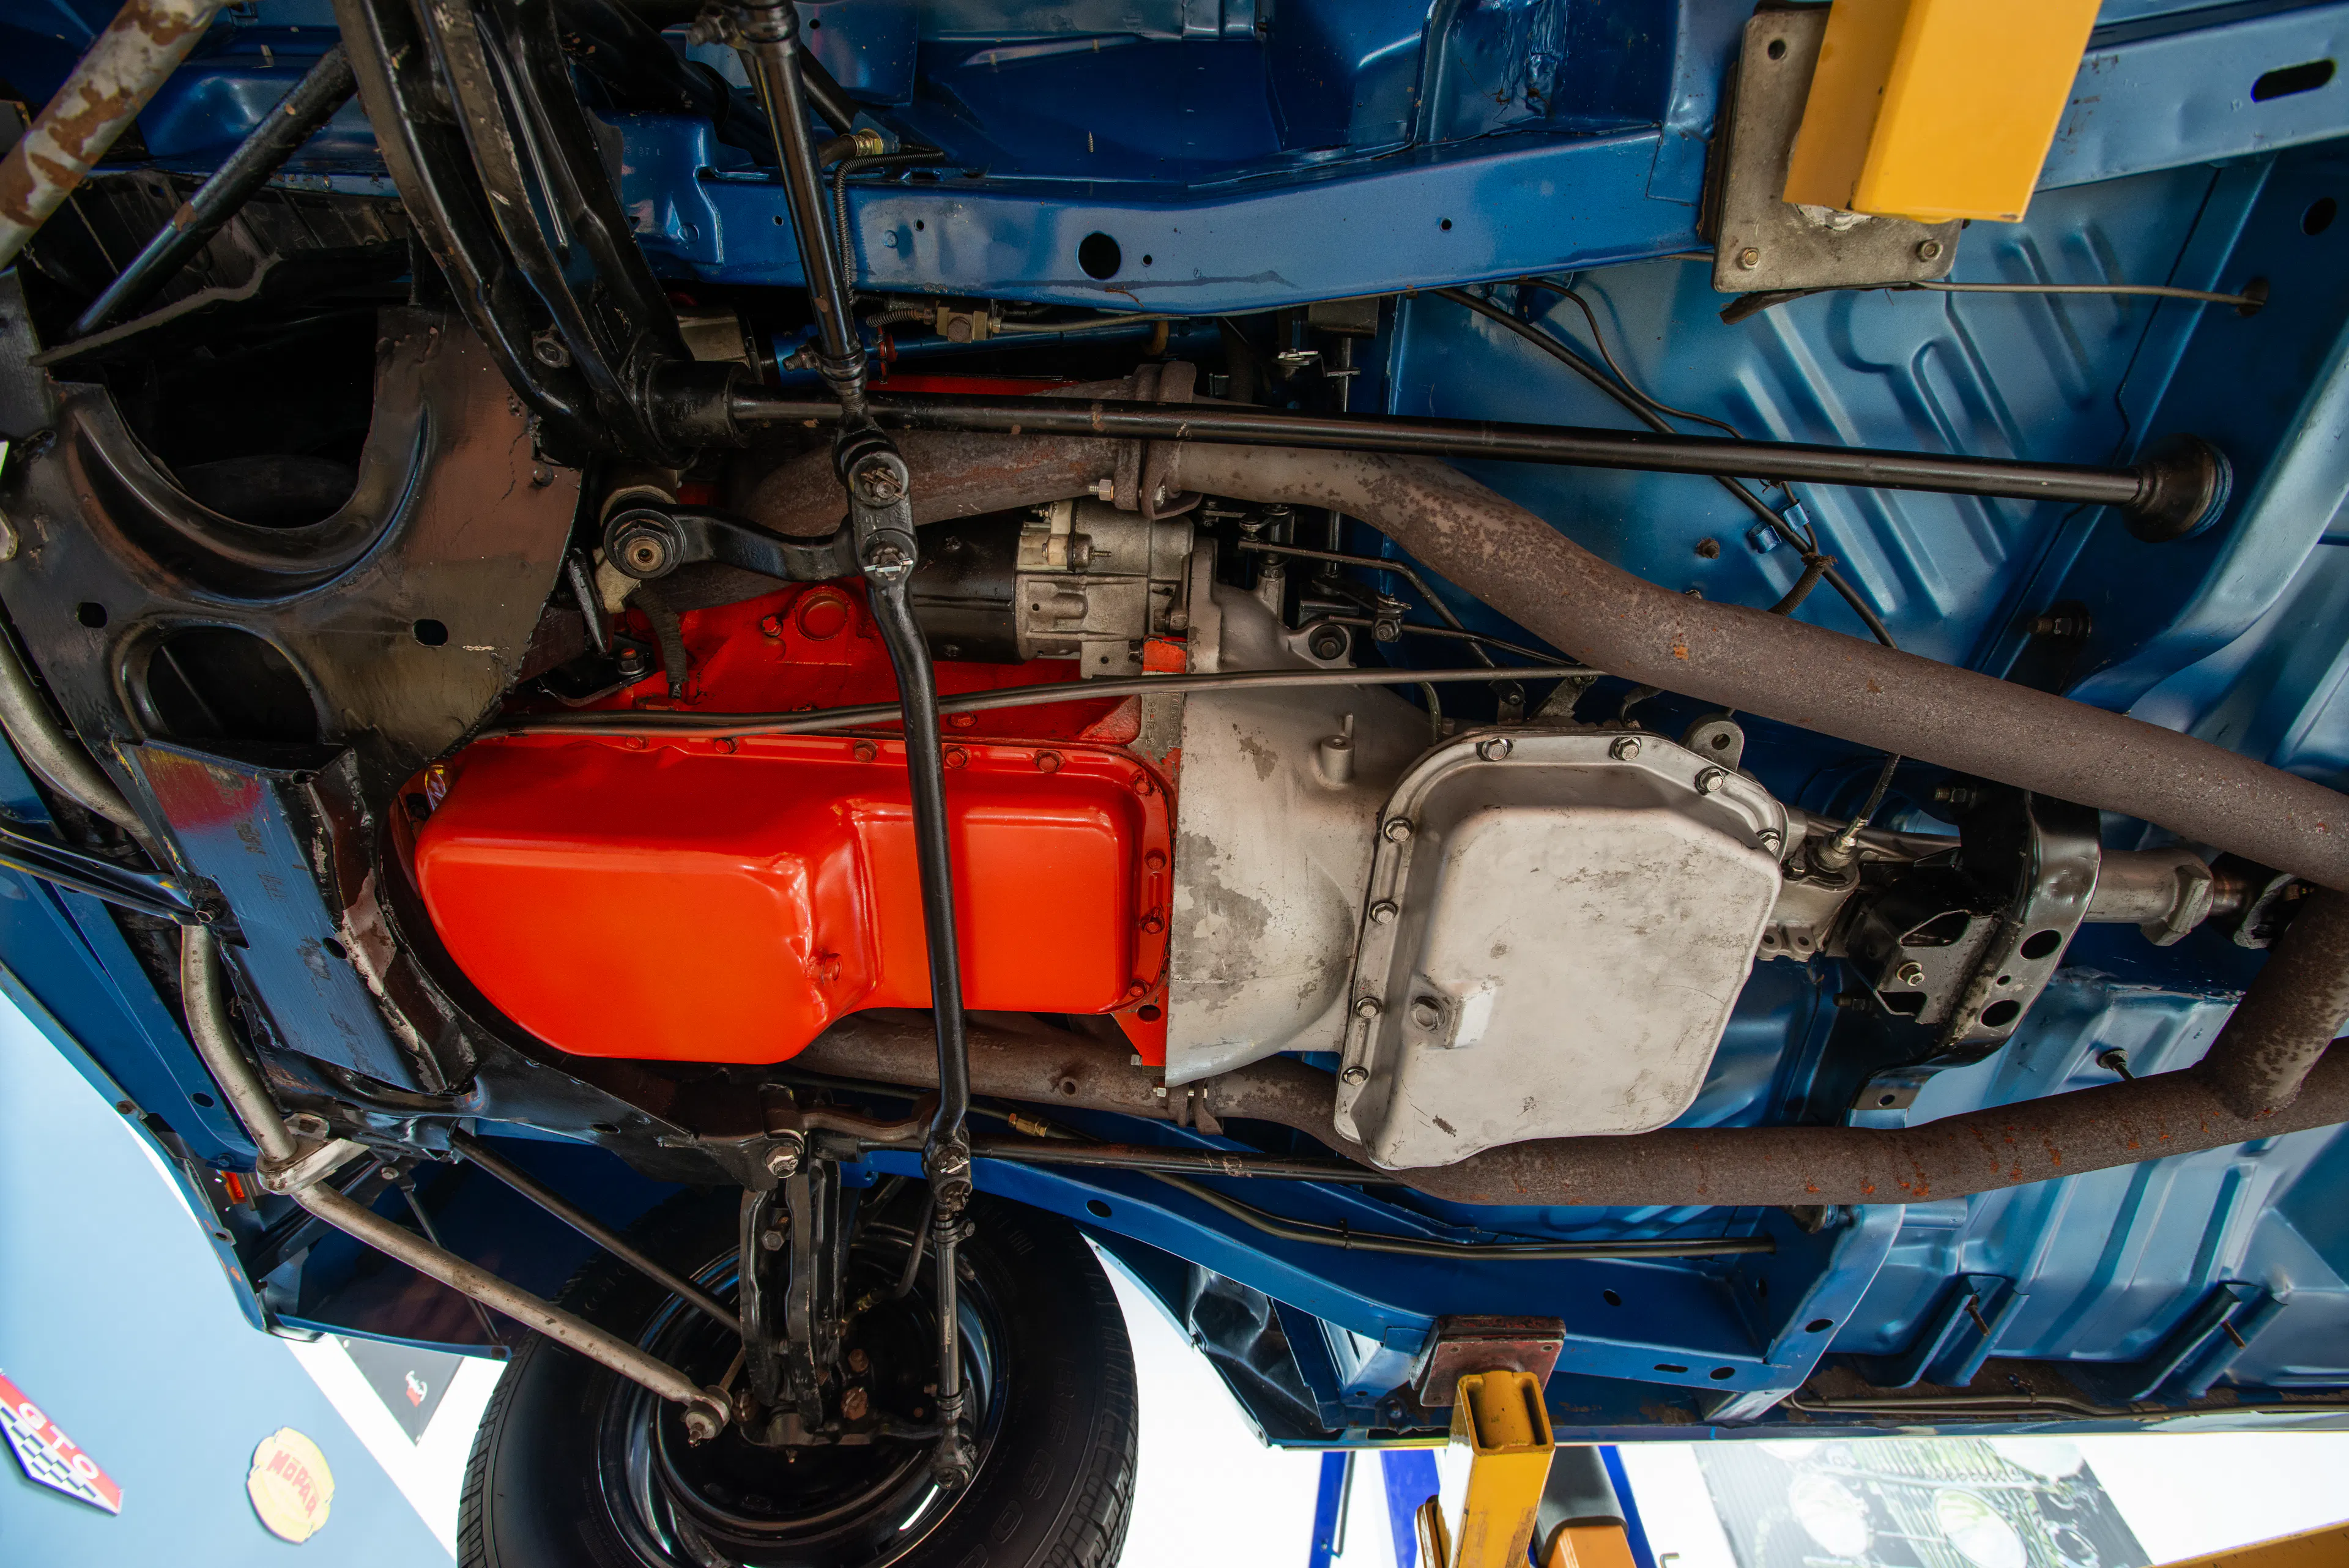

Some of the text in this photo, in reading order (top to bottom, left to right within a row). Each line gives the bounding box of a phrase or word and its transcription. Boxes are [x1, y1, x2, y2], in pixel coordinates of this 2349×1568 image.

[1146, 702, 1156, 745] 3-21-68
[18, 1402, 99, 1480] GTO
[265, 1449, 319, 1519] MOPAR
